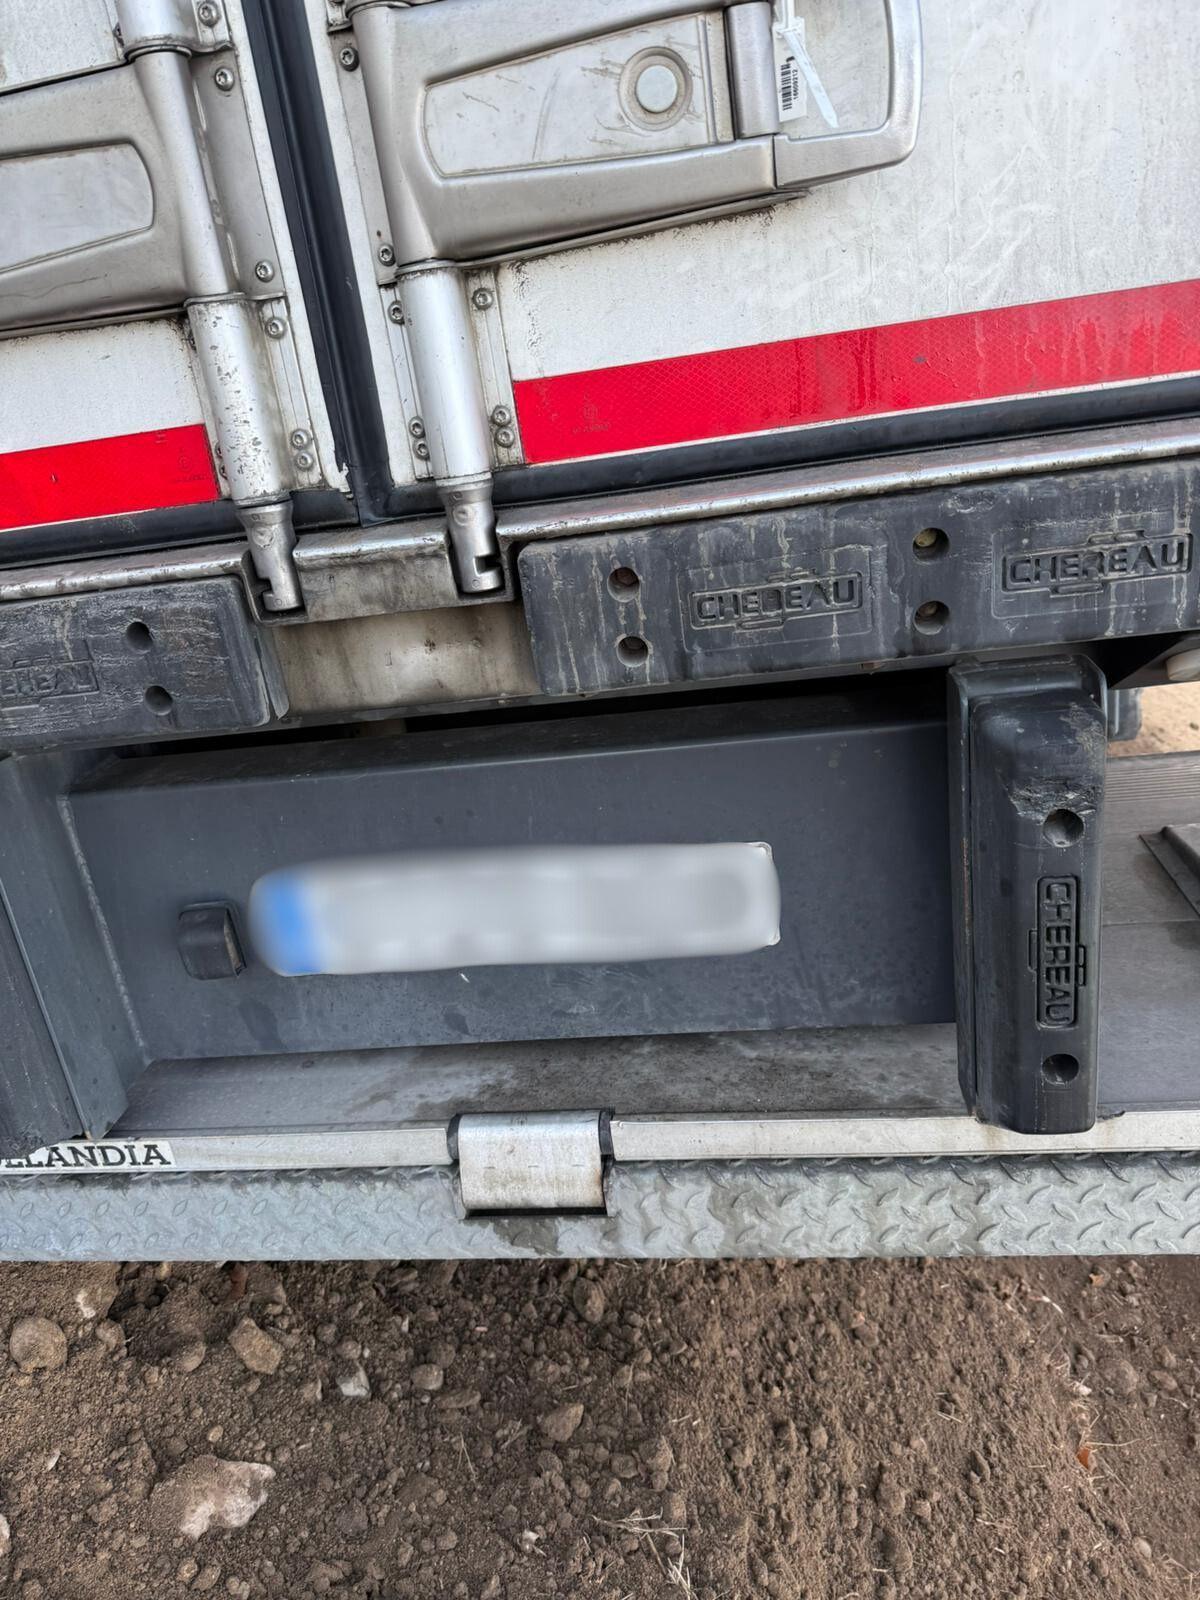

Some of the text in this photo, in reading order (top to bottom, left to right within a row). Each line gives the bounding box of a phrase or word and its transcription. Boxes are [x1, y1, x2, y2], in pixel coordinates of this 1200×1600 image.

[1009, 541, 1186, 586] CHEREAU
[696, 578, 856, 622] CHEREAU
[1044, 882, 1072, 1023] CHEREAU
